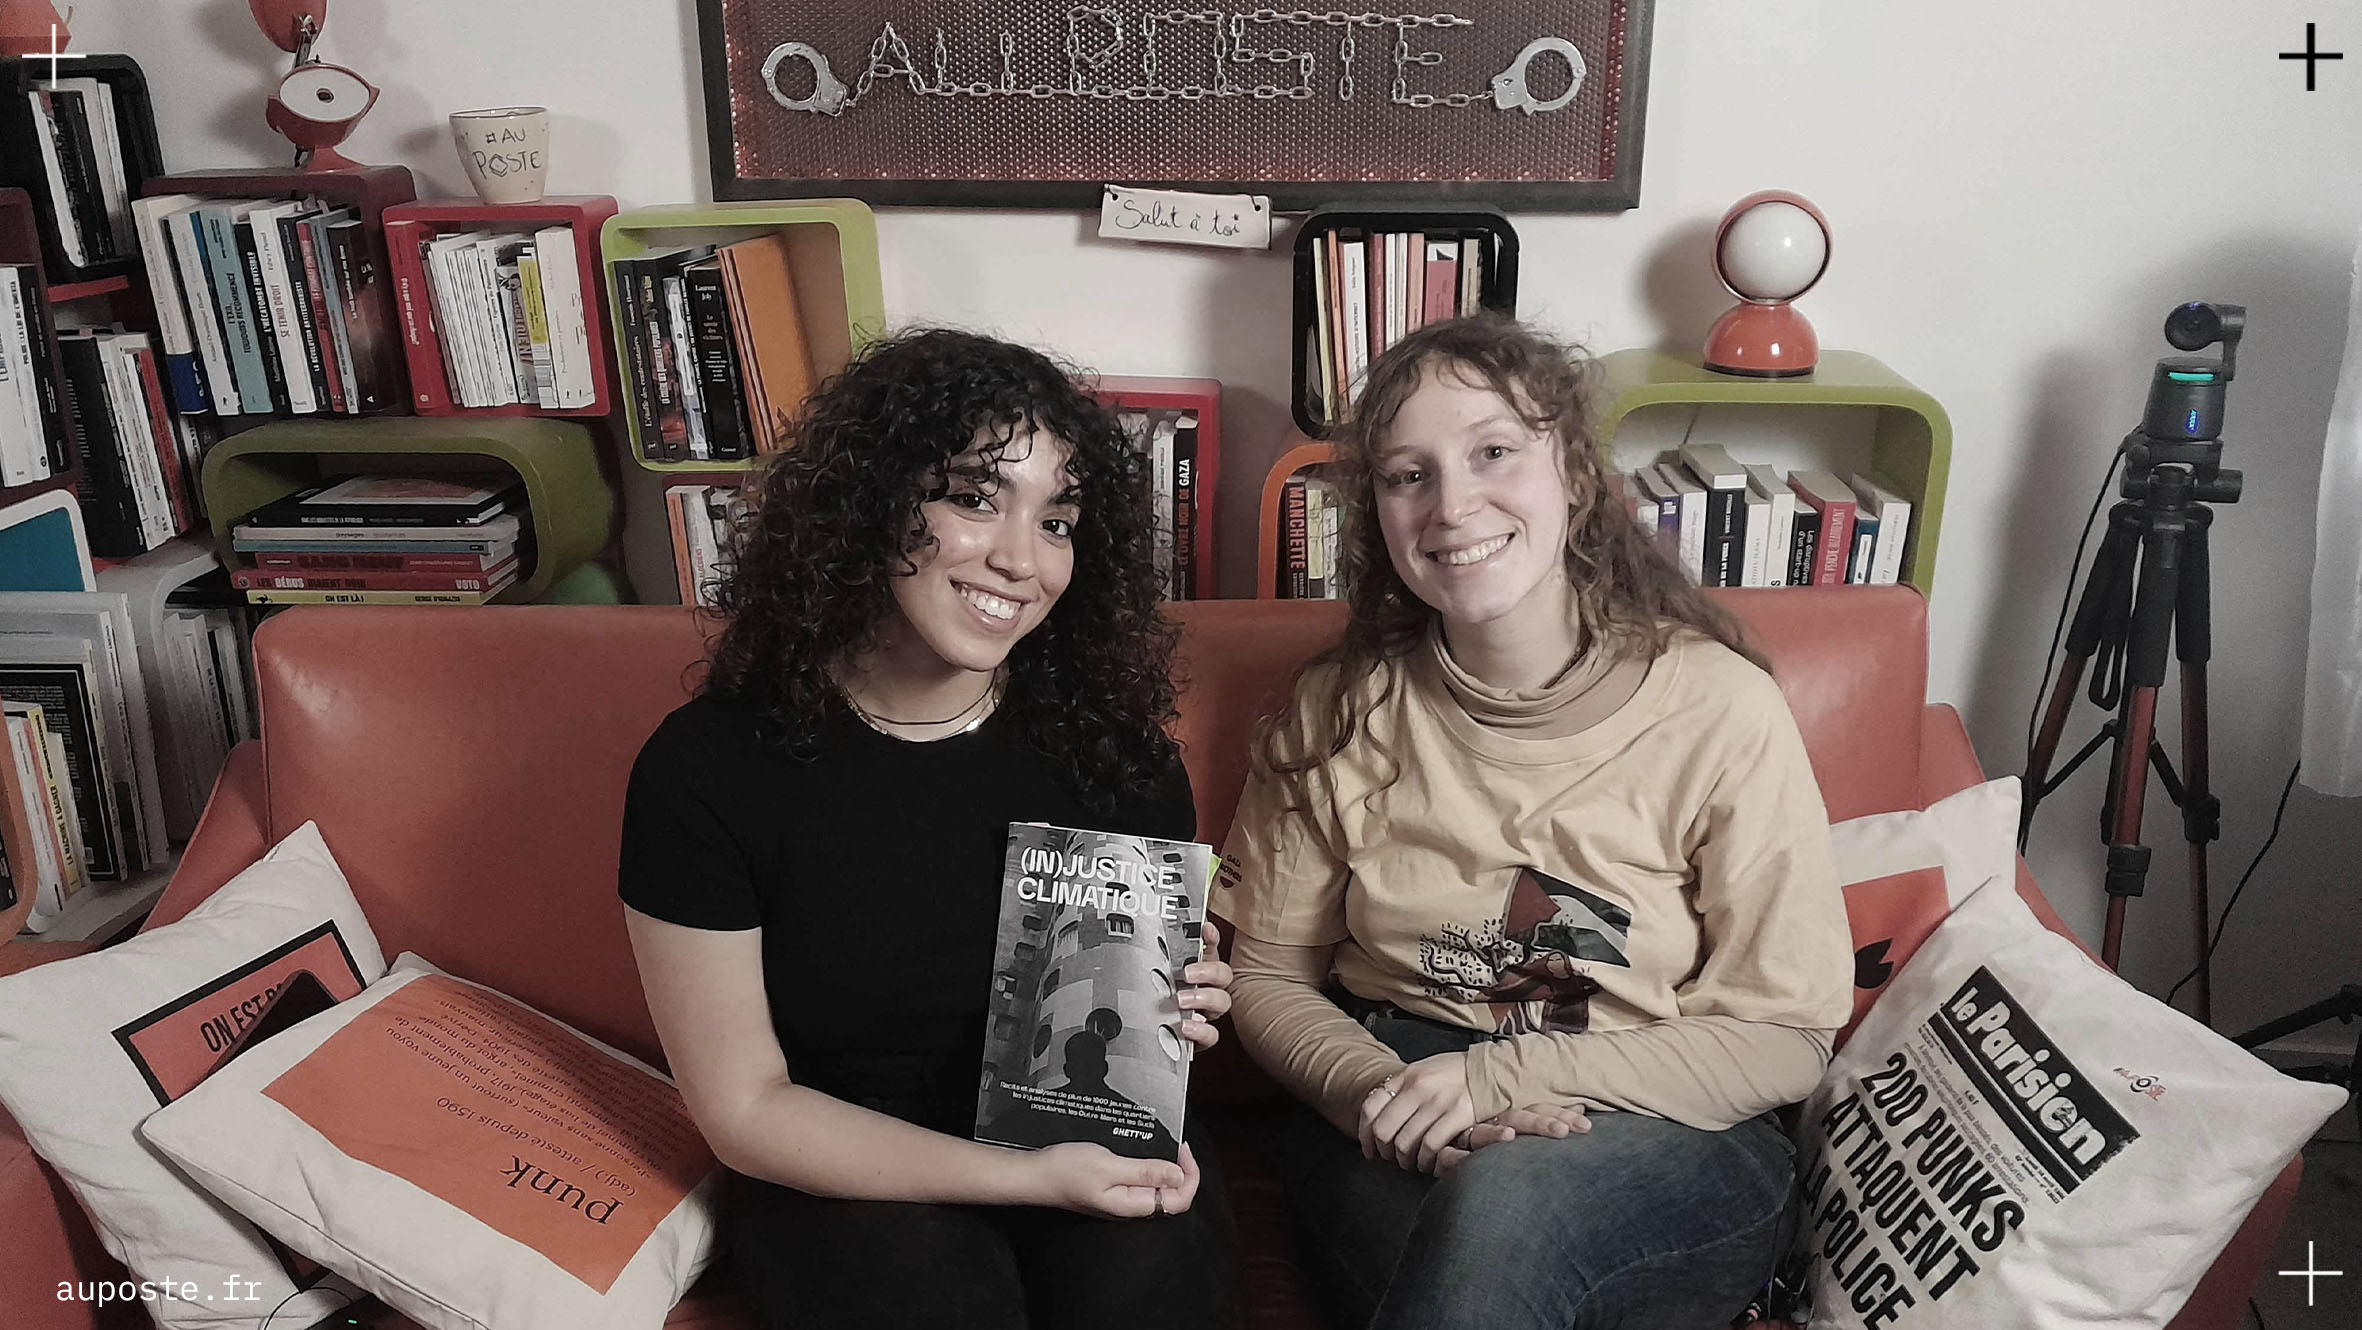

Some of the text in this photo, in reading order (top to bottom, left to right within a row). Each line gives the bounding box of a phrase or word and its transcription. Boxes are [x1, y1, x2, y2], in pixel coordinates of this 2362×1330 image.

[472, 150, 541, 179] POSTE
[1115, 199, 1240, 237] Salut à toi
[247, 251, 264, 285] INVISIBLE
[269, 284, 285, 306] DROIT
[695, 284, 717, 292] Laurent
[633, 335, 646, 386] contestataires
[639, 386, 648, 399] des
[1178, 458, 1189, 486] GAZA
[1178, 487, 1188, 500] DE
[1289, 486, 1306, 569] MANCHETTE
[1793, 548, 1803, 578] start-up
[275, 575, 304, 590] BÉRUS
[455, 579, 480, 591] VOTO
[337, 595, 350, 603] EST
[1021, 846, 1176, 890] (IN)JUSTICE
[1017, 876, 1178, 920] CLIMATIQUE
[198, 995, 263, 1054] ON EST
[392, 1014, 410, 1028] de
[417, 1014, 459, 1039] monde
[386, 1026, 421, 1050] voyou
[409, 1024, 490, 1076] probablement
[458, 1037, 476, 1051] du
[421, 1047, 455, 1070] jeune
[476, 1047, 507, 1069] argot
[454, 1069, 471, 1082] un
[1950, 985, 1980, 1024] le
[1966, 1000, 2107, 1166] Parisien
[435, 1095, 475, 1120] 1590
[470, 1082, 519, 1108] (surtout
[1022, 1092, 1055, 1104] injustices
[1055, 1097, 1094, 1112] climatiques
[1094, 1104, 1111, 1113] dans
[1111, 1107, 1122, 1115] les
[1121, 1109, 1155, 1121] quartiers
[1027, 1085, 1057, 1097] analyses
[1058, 1090, 1067, 1098] de
[1067, 1092, 1083, 1101] plus
[1082, 1094, 1092, 1102] de
[1092, 1095, 1109, 1105] 1000
[1108, 1098, 1132, 1109] jeunes
[1132, 1102, 1156, 1112] contre
[475, 1114, 529, 1140] depuis
[557, 1106, 579, 1122] bas
[579, 1118, 596, 1131] de
[1067, 1107, 1078, 1116] les
[1126, 1118, 1137, 1126] les
[567, 1124, 593, 1143] sans
[595, 1127, 645, 1159] criminel
[1111, 1126, 1154, 1140] GHETT'UP
[527, 1137, 581, 1167] attesté
[1860, 1052, 1928, 1127] 200
[1901, 1106, 2026, 1252] PUNKS
[2000, 1154, 2025, 1183] voitures
[499, 1154, 624, 1225] punk
[593, 1167, 637, 1198] (adj.)
[1821, 1091, 1981, 1302] ATTAQUENT
[1814, 1187, 1916, 1330] POLICE
